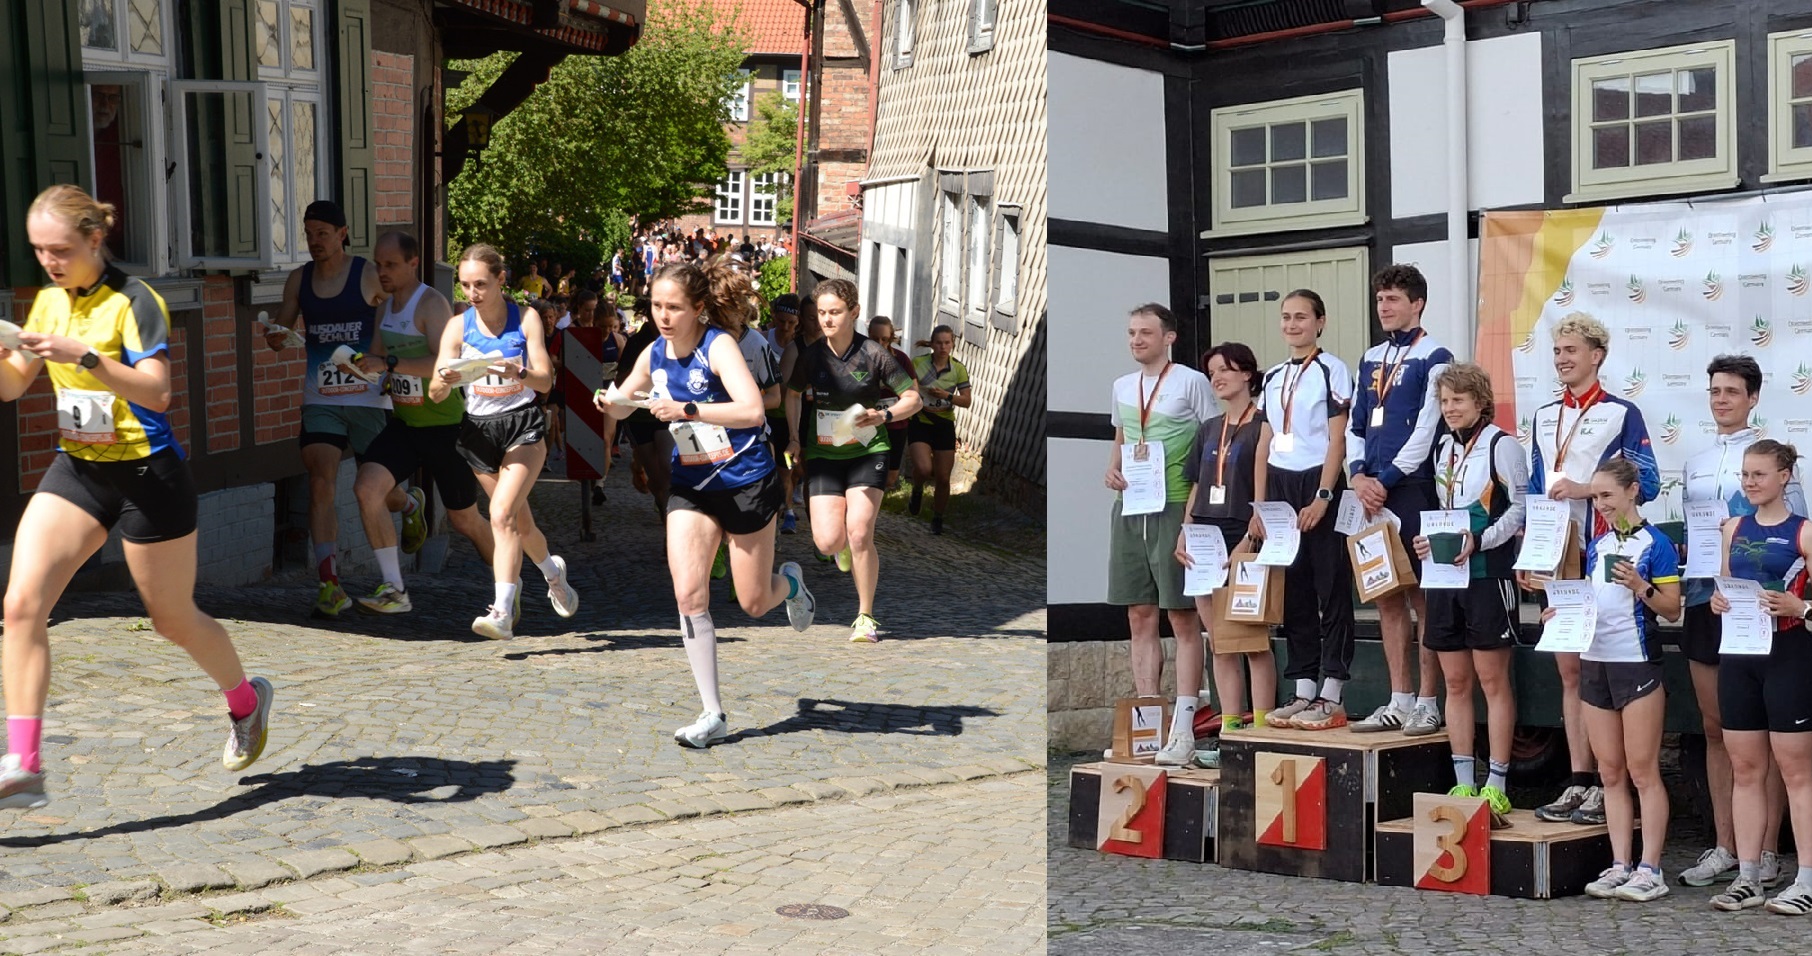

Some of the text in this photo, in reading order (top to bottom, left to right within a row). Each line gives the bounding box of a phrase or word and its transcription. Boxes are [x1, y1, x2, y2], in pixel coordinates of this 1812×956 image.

[308, 321, 362, 335] AUSDAUER
[319, 331, 360, 343] SCHULE
[73, 405, 82, 430] 9
[688, 434, 723, 452] 1 1
[1108, 774, 1147, 844] 2
[1270, 759, 1297, 843] 1
[1427, 805, 1469, 883] 3
